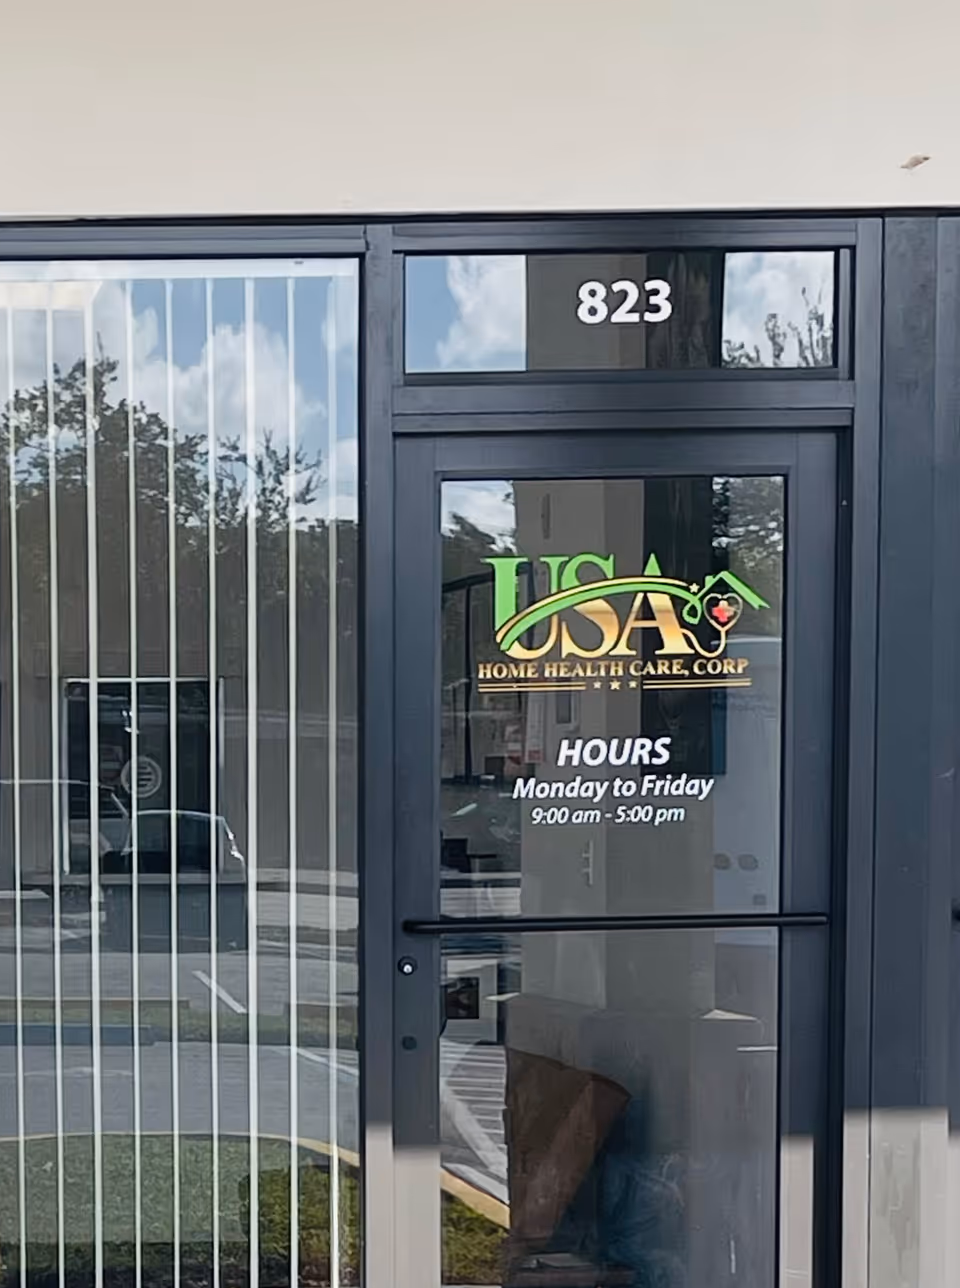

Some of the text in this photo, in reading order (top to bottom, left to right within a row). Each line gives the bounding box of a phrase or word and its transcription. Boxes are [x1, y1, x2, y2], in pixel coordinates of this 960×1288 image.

[576, 279, 674, 325] 823
[481, 553, 695, 660] USA
[478, 657, 750, 679] HOME HEALTH CARE, CORP
[556, 736, 672, 767] HOURS
[512, 772, 715, 803] Monday to Friday
[531, 806, 569, 825] 9:00
[571, 809, 601, 824] am
[614, 805, 653, 824] 5:00
[654, 806, 686, 826] pm
